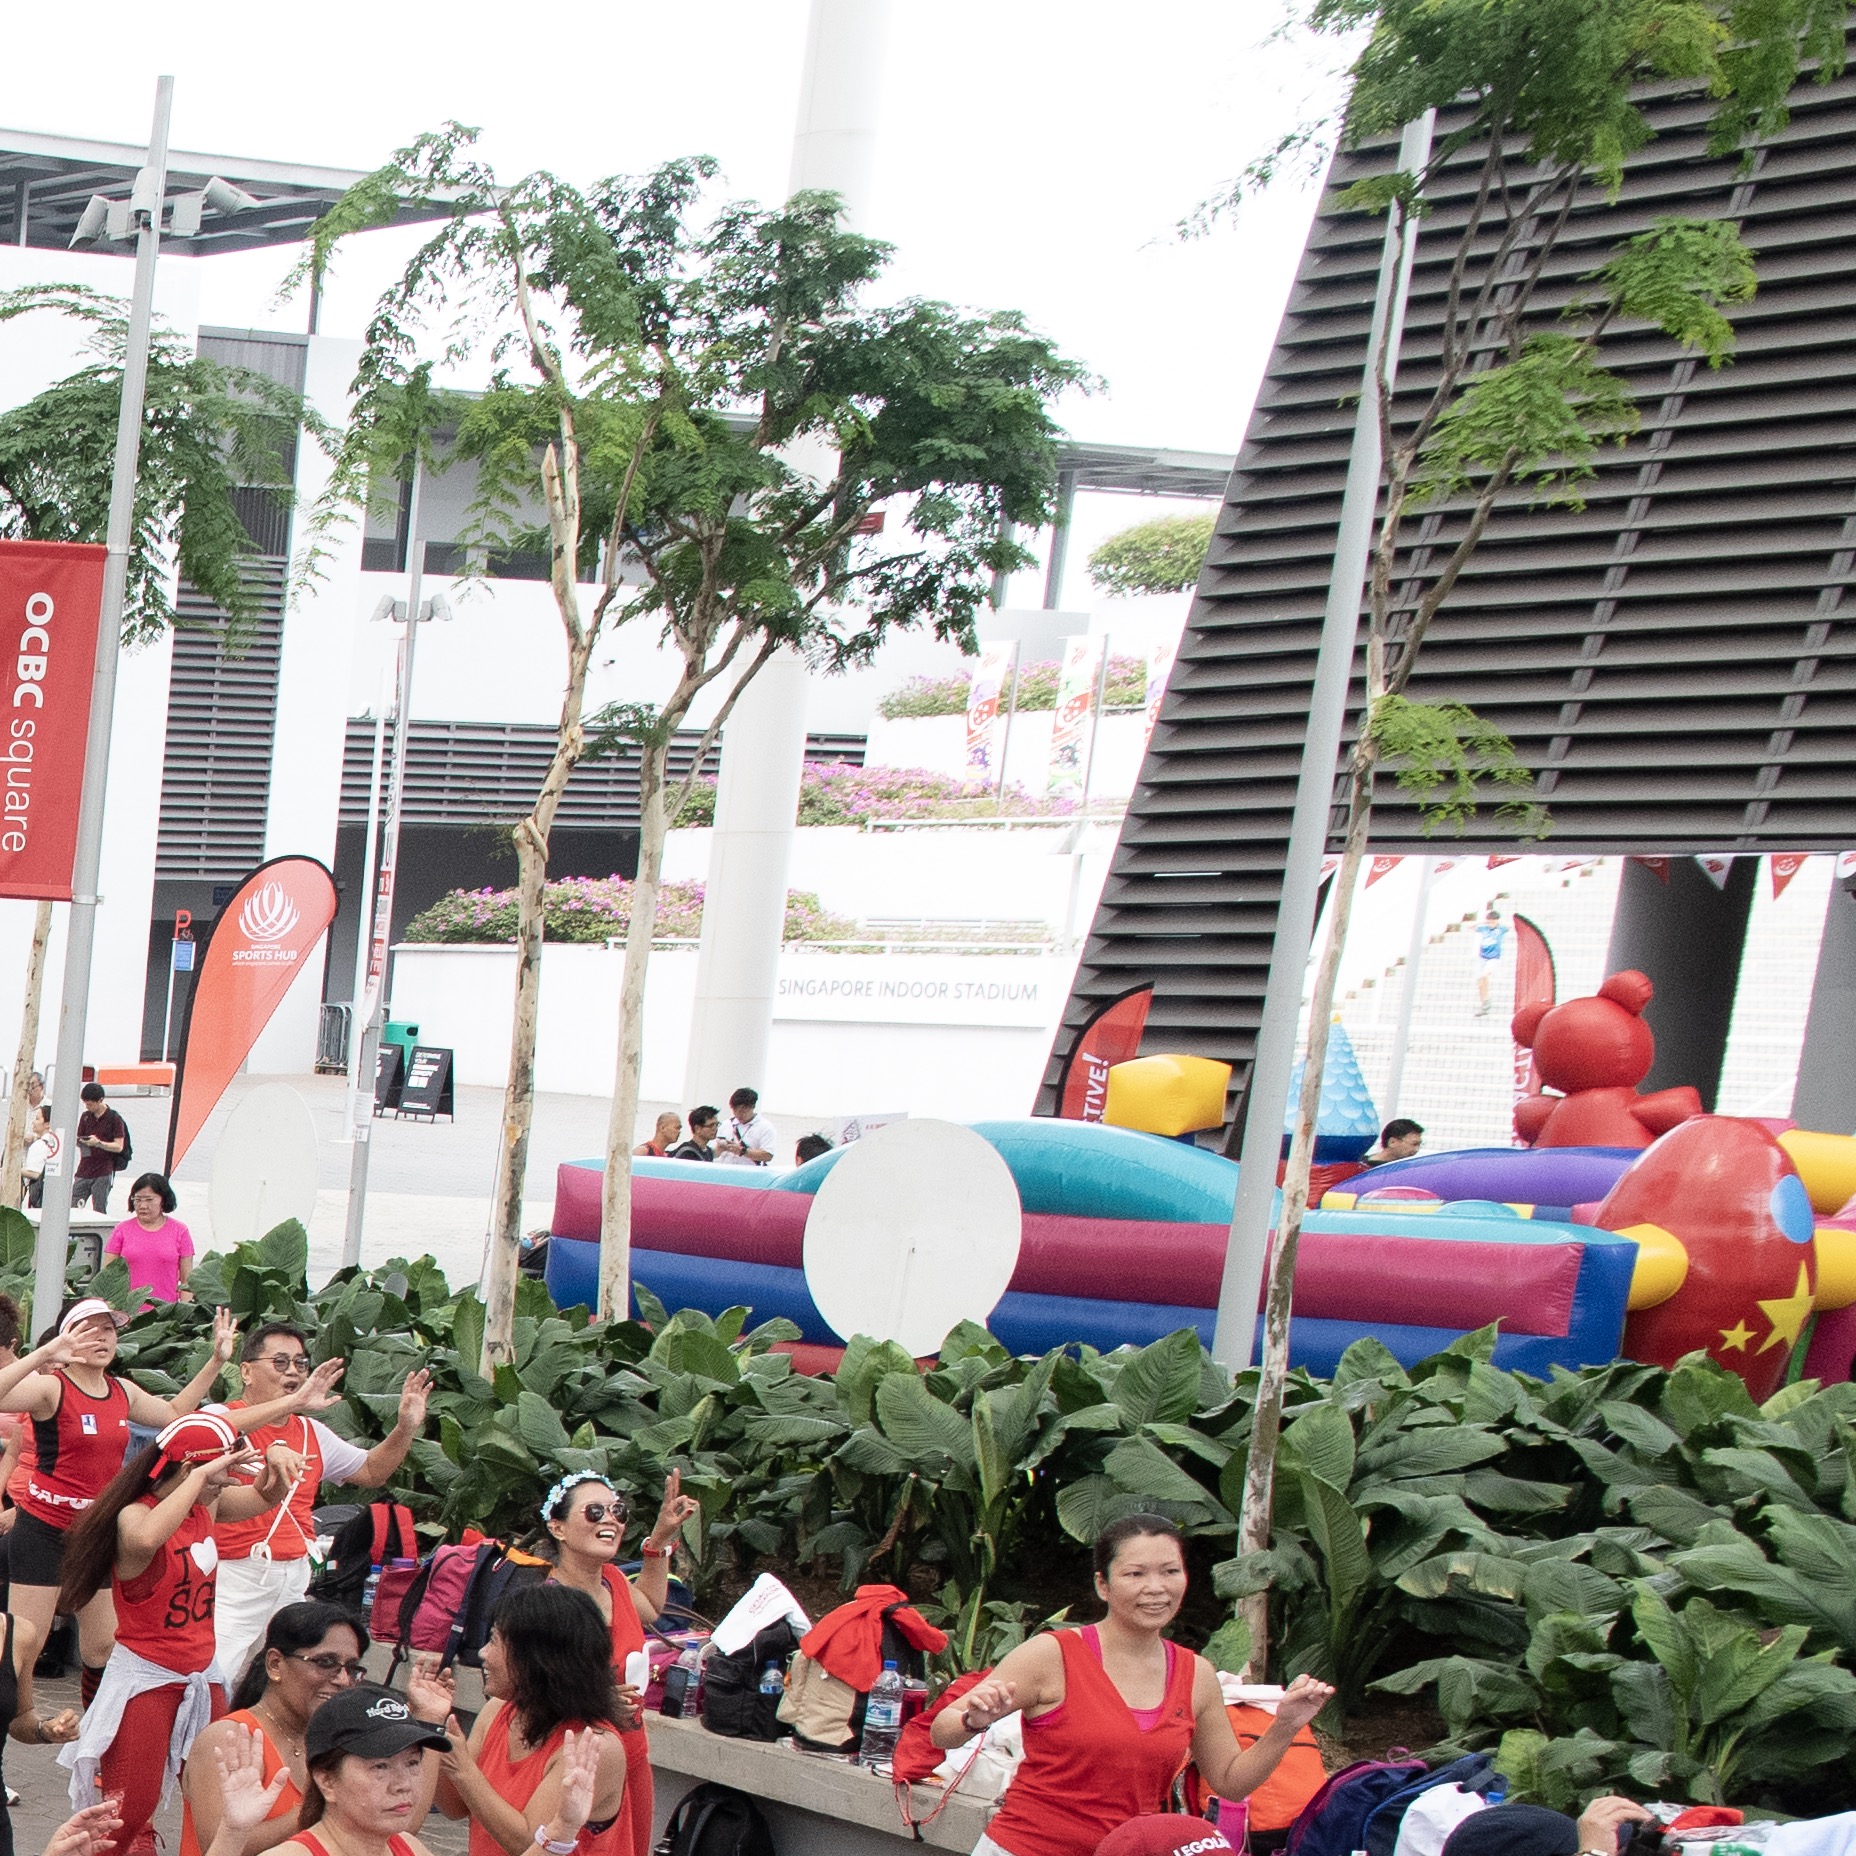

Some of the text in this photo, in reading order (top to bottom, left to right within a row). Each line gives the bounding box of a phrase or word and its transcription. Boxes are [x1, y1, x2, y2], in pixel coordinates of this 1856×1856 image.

[13, 591, 55, 709] OCBC
[232, 950, 298, 961] SPORTS HUB
[778, 979, 1038, 1000] SINGAPORE INDOOR STADIUM
[173, 1545, 191, 1589] I
[164, 1581, 216, 1630] SG
